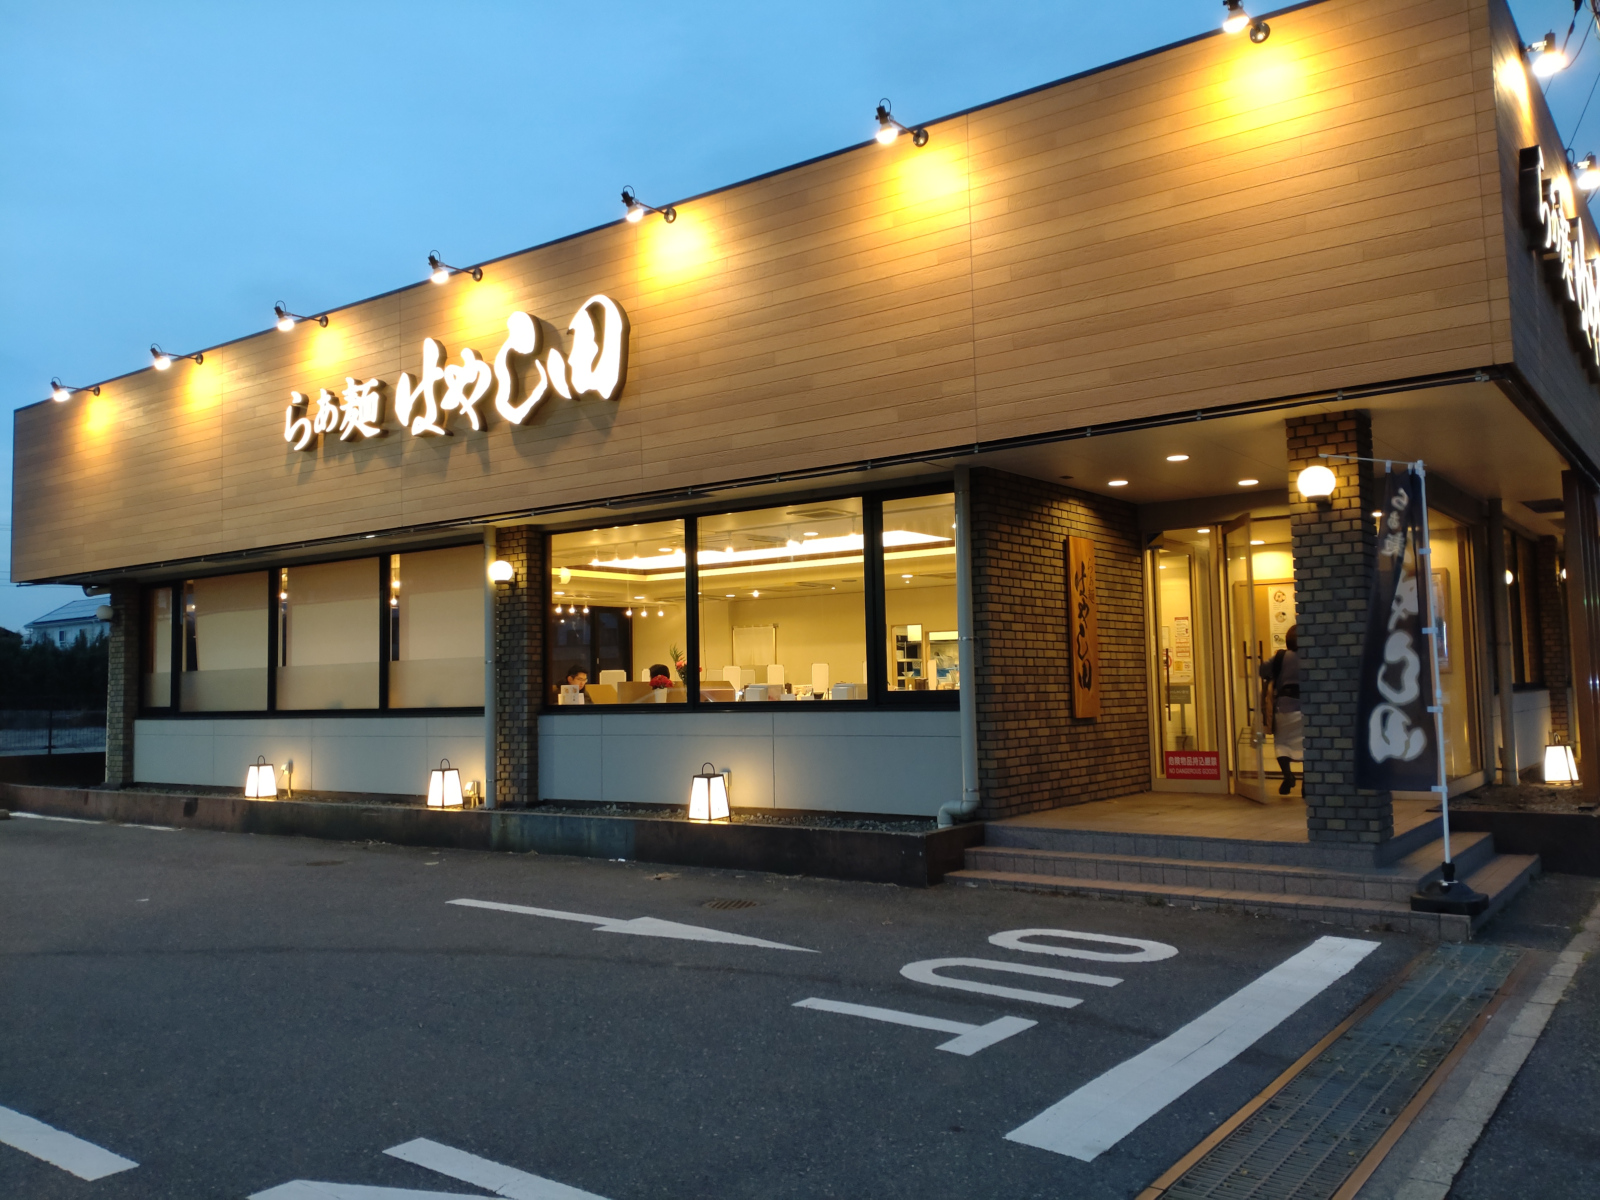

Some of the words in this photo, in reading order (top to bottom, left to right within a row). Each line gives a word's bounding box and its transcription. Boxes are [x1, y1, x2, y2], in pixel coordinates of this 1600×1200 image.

[395, 294, 624, 436] はやし田
[1075, 560, 1092, 691] はやし田
